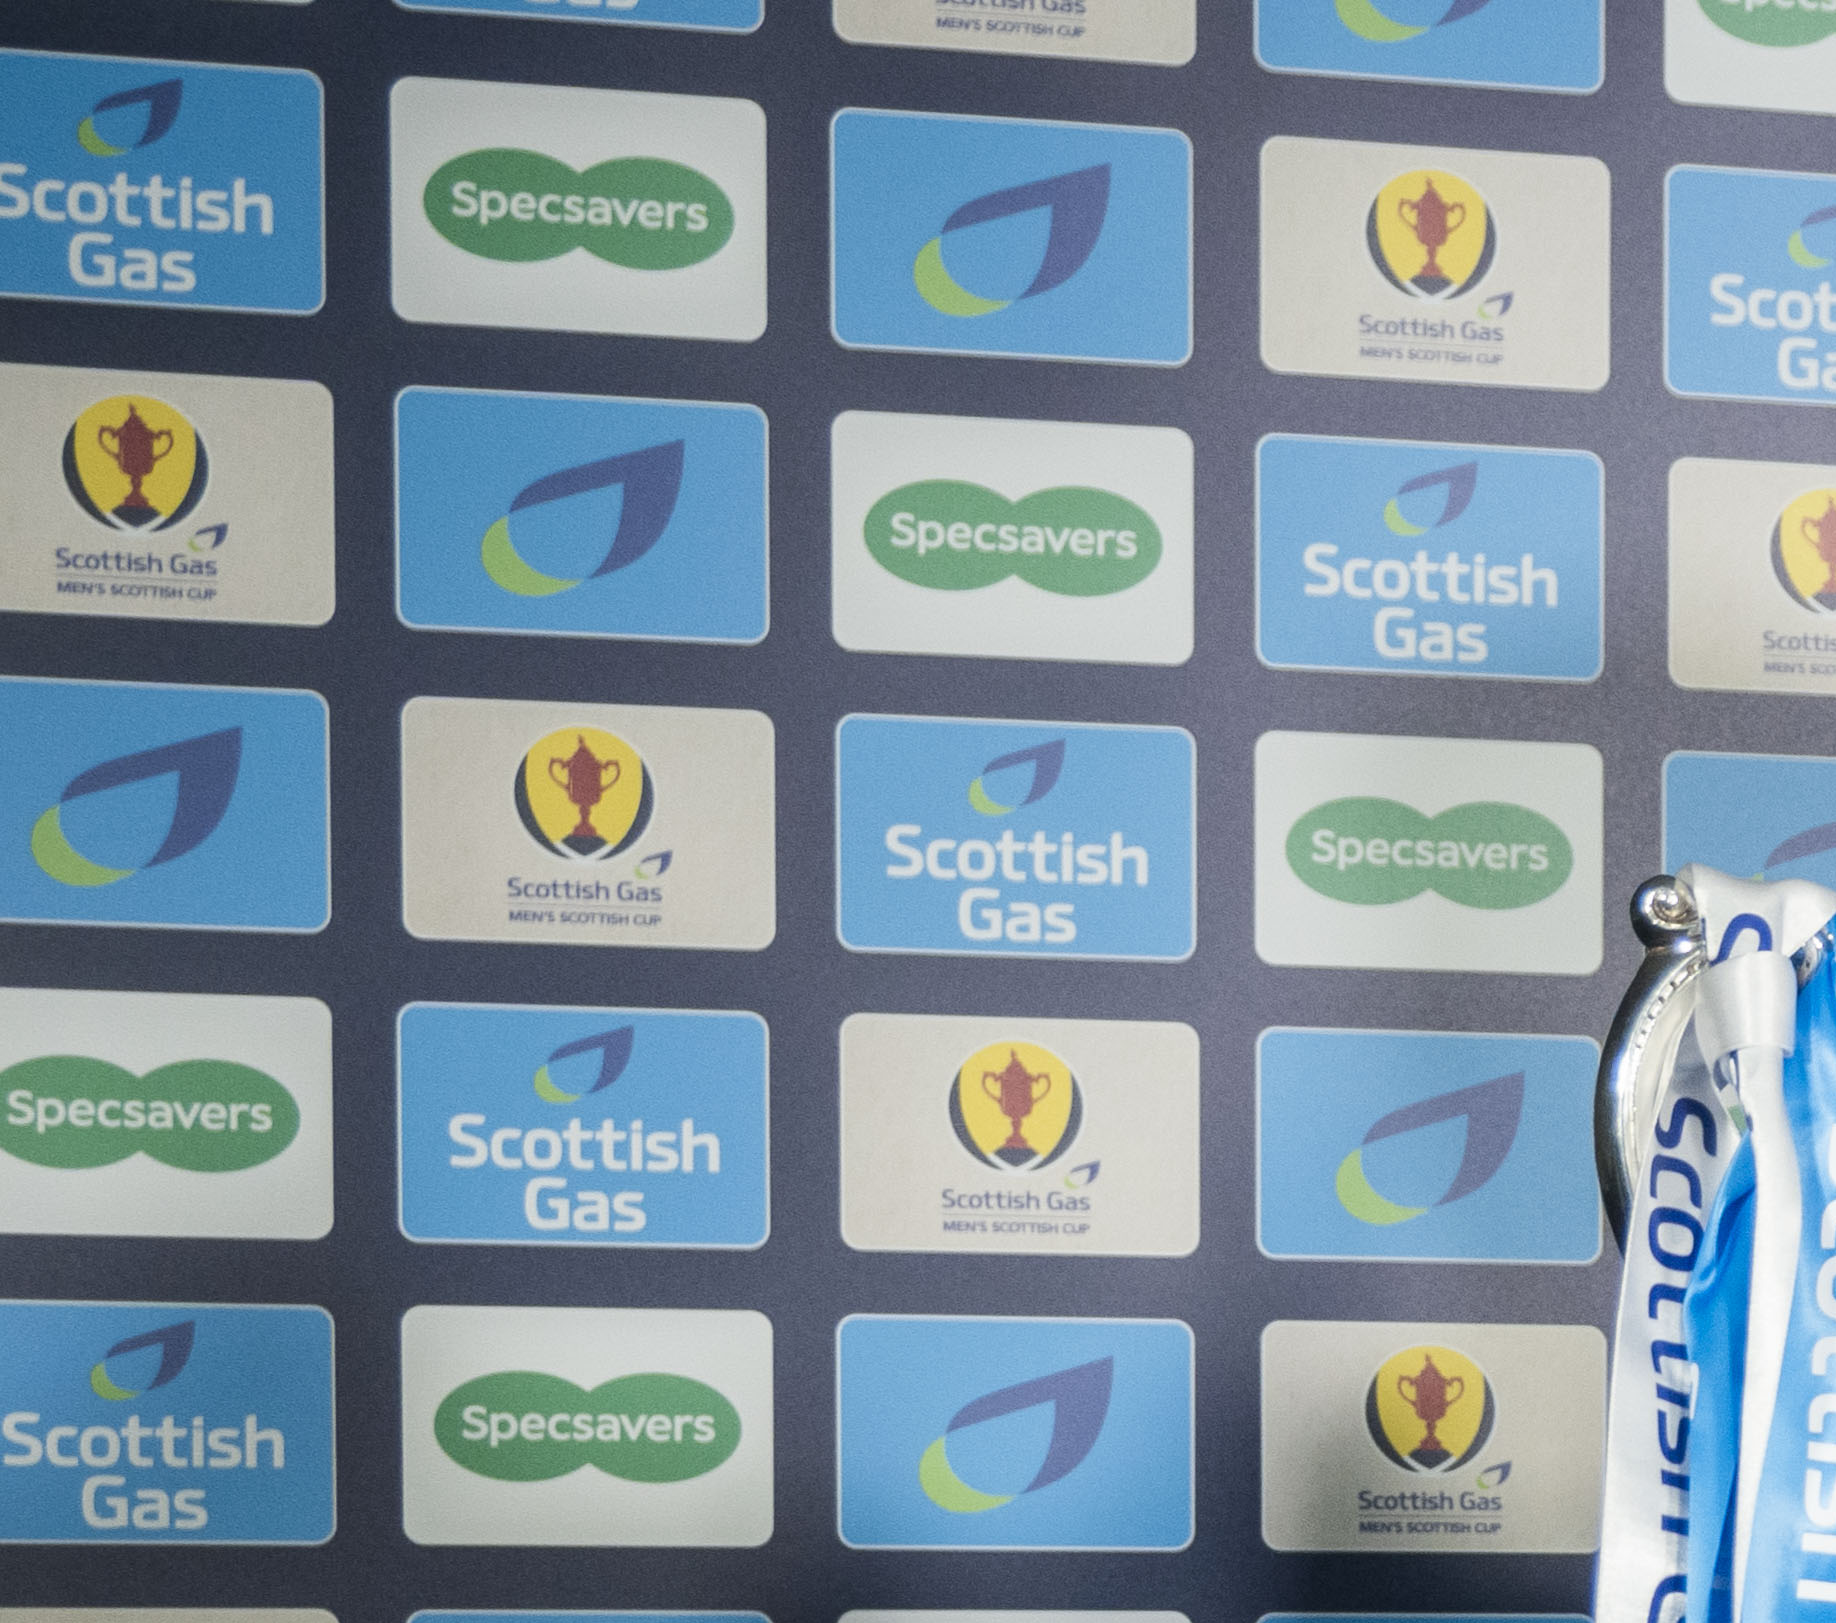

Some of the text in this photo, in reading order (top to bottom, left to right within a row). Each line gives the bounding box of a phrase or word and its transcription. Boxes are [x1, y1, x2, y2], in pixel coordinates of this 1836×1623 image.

[0, 160, 275, 237] Scottish
[451, 179, 709, 232] Specsavers
[66, 229, 198, 295] Gas
[1358, 313, 1505, 344] Scottish Gas
[890, 511, 1138, 559] Specsavers
[55, 547, 218, 577] Scottish Gas
[1301, 540, 1560, 609] Scottish
[1371, 604, 1489, 664] Gas
[883, 822, 1151, 889] Scottish
[1311, 828, 1550, 873] Specsavers
[507, 876, 663, 904] Scottish Gas
[559, 910, 630, 927] SCOTTISH
[956, 885, 1079, 946] Gas
[6, 1088, 273, 1134] Specsavers
[447, 1111, 722, 1176] Scottish
[522, 1174, 648, 1234] Gas
[941, 1187, 1092, 1213] Scottish Gas
[0, 1409, 287, 1470] Scottish
[461, 1404, 717, 1448] Specsavers
[79, 1473, 210, 1531] Gas
[1357, 1490, 1503, 1512] Scottish Gas
[1406, 1521, 1471, 1535] SCOTTISH
